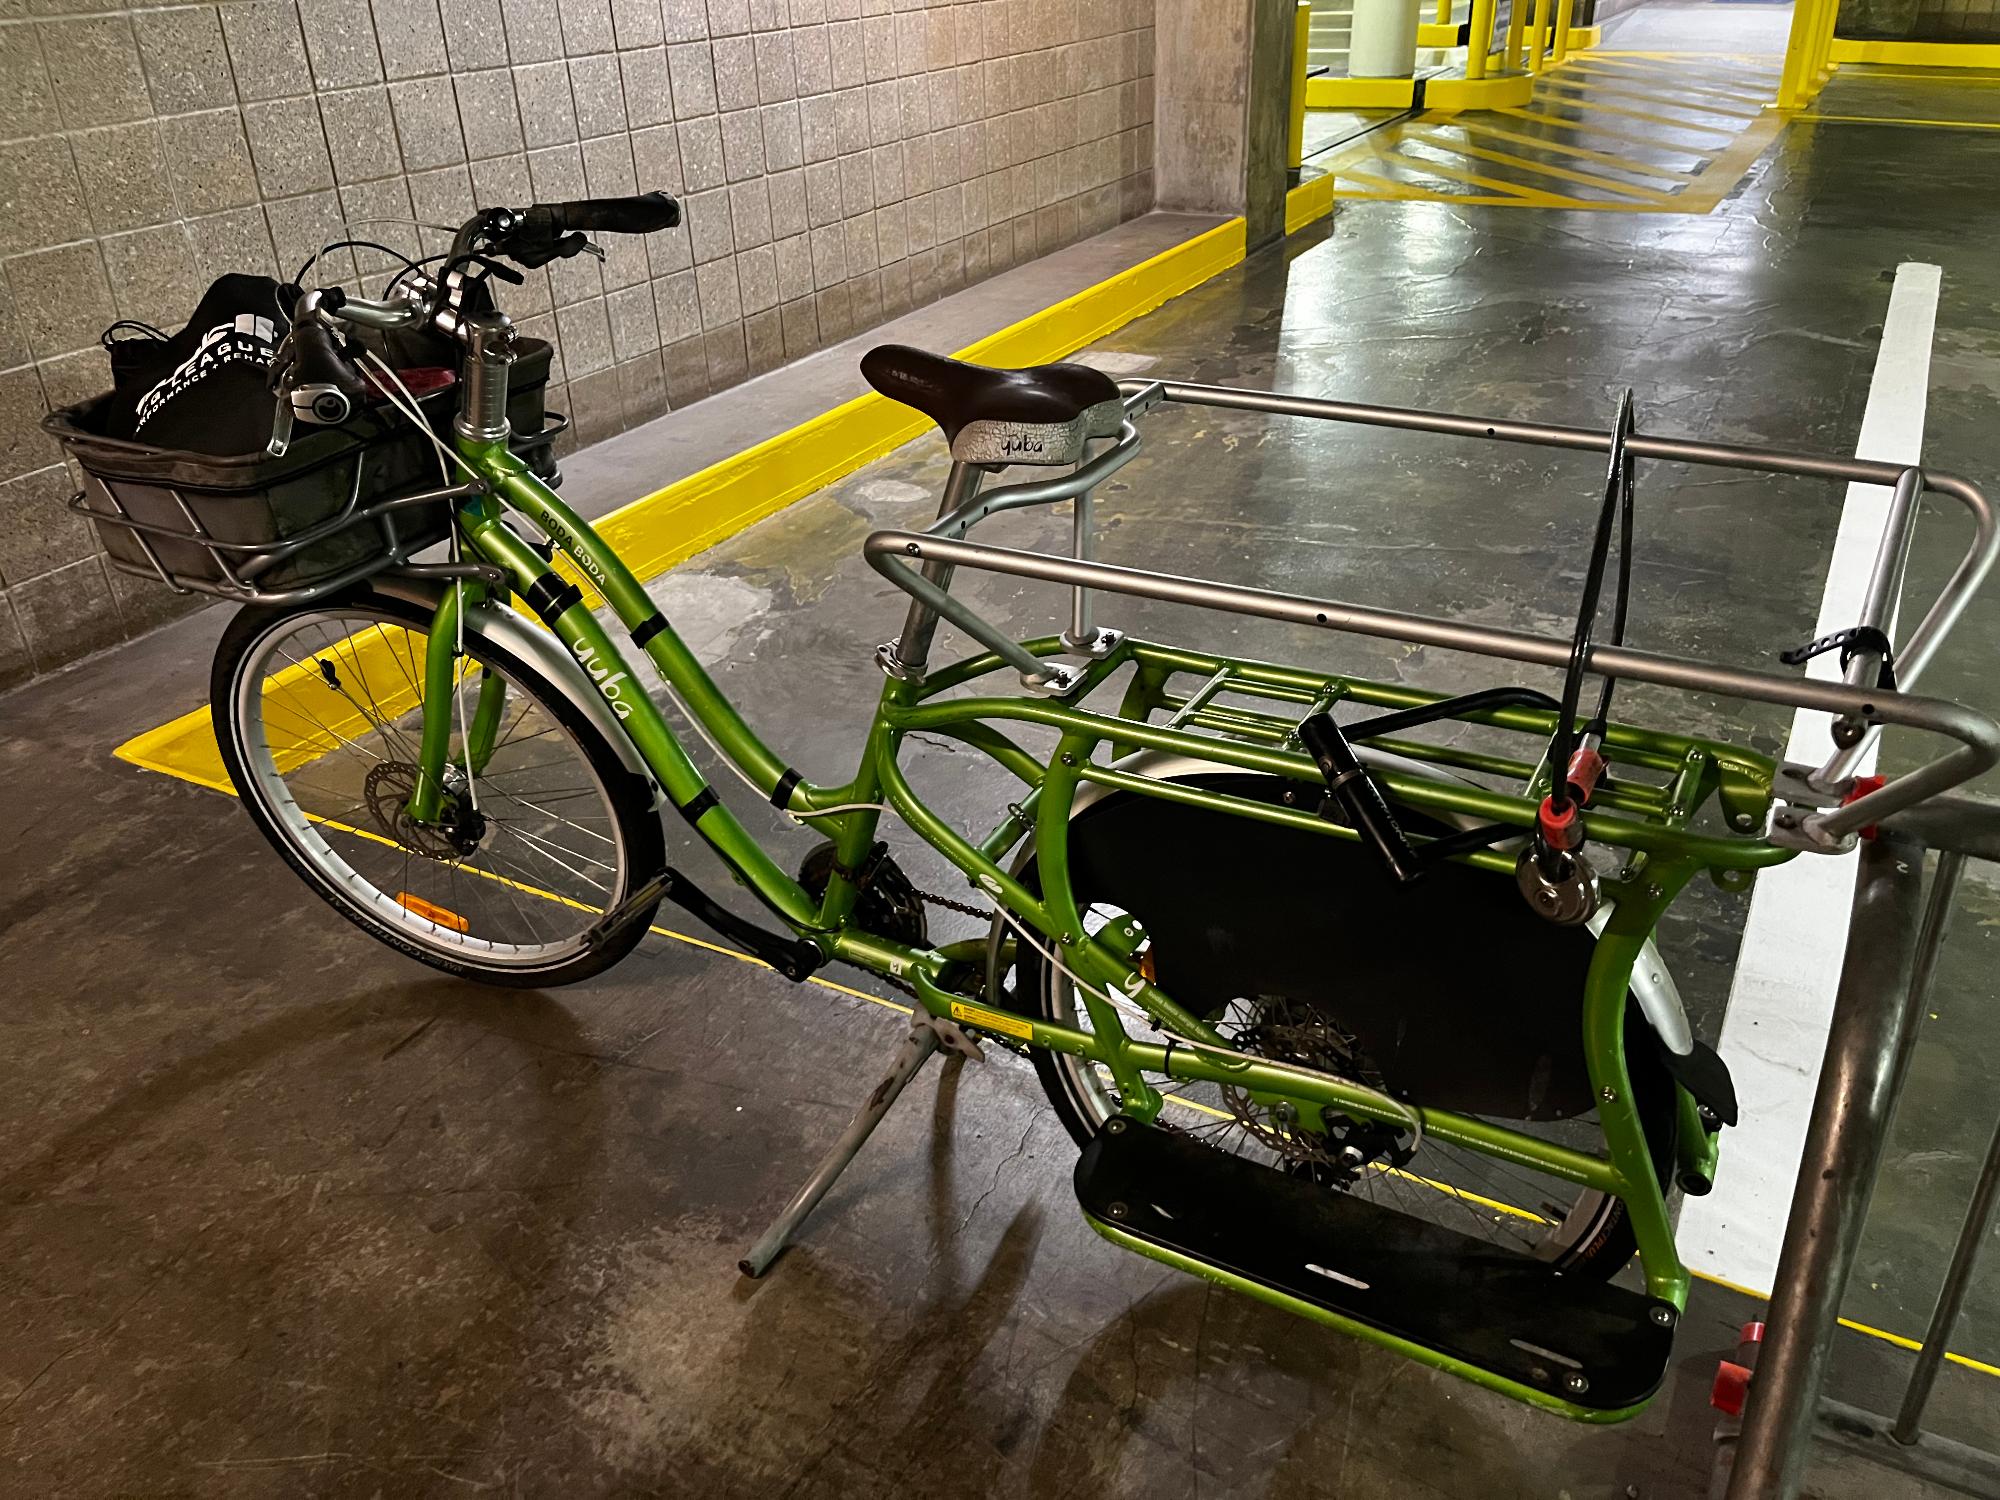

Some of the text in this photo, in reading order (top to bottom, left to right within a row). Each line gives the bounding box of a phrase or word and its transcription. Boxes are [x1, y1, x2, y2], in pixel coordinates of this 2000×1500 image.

[171, 340, 274, 388] LEAGUE
[541, 510, 606, 586] BODA BODA
[572, 637, 634, 720] yuba
